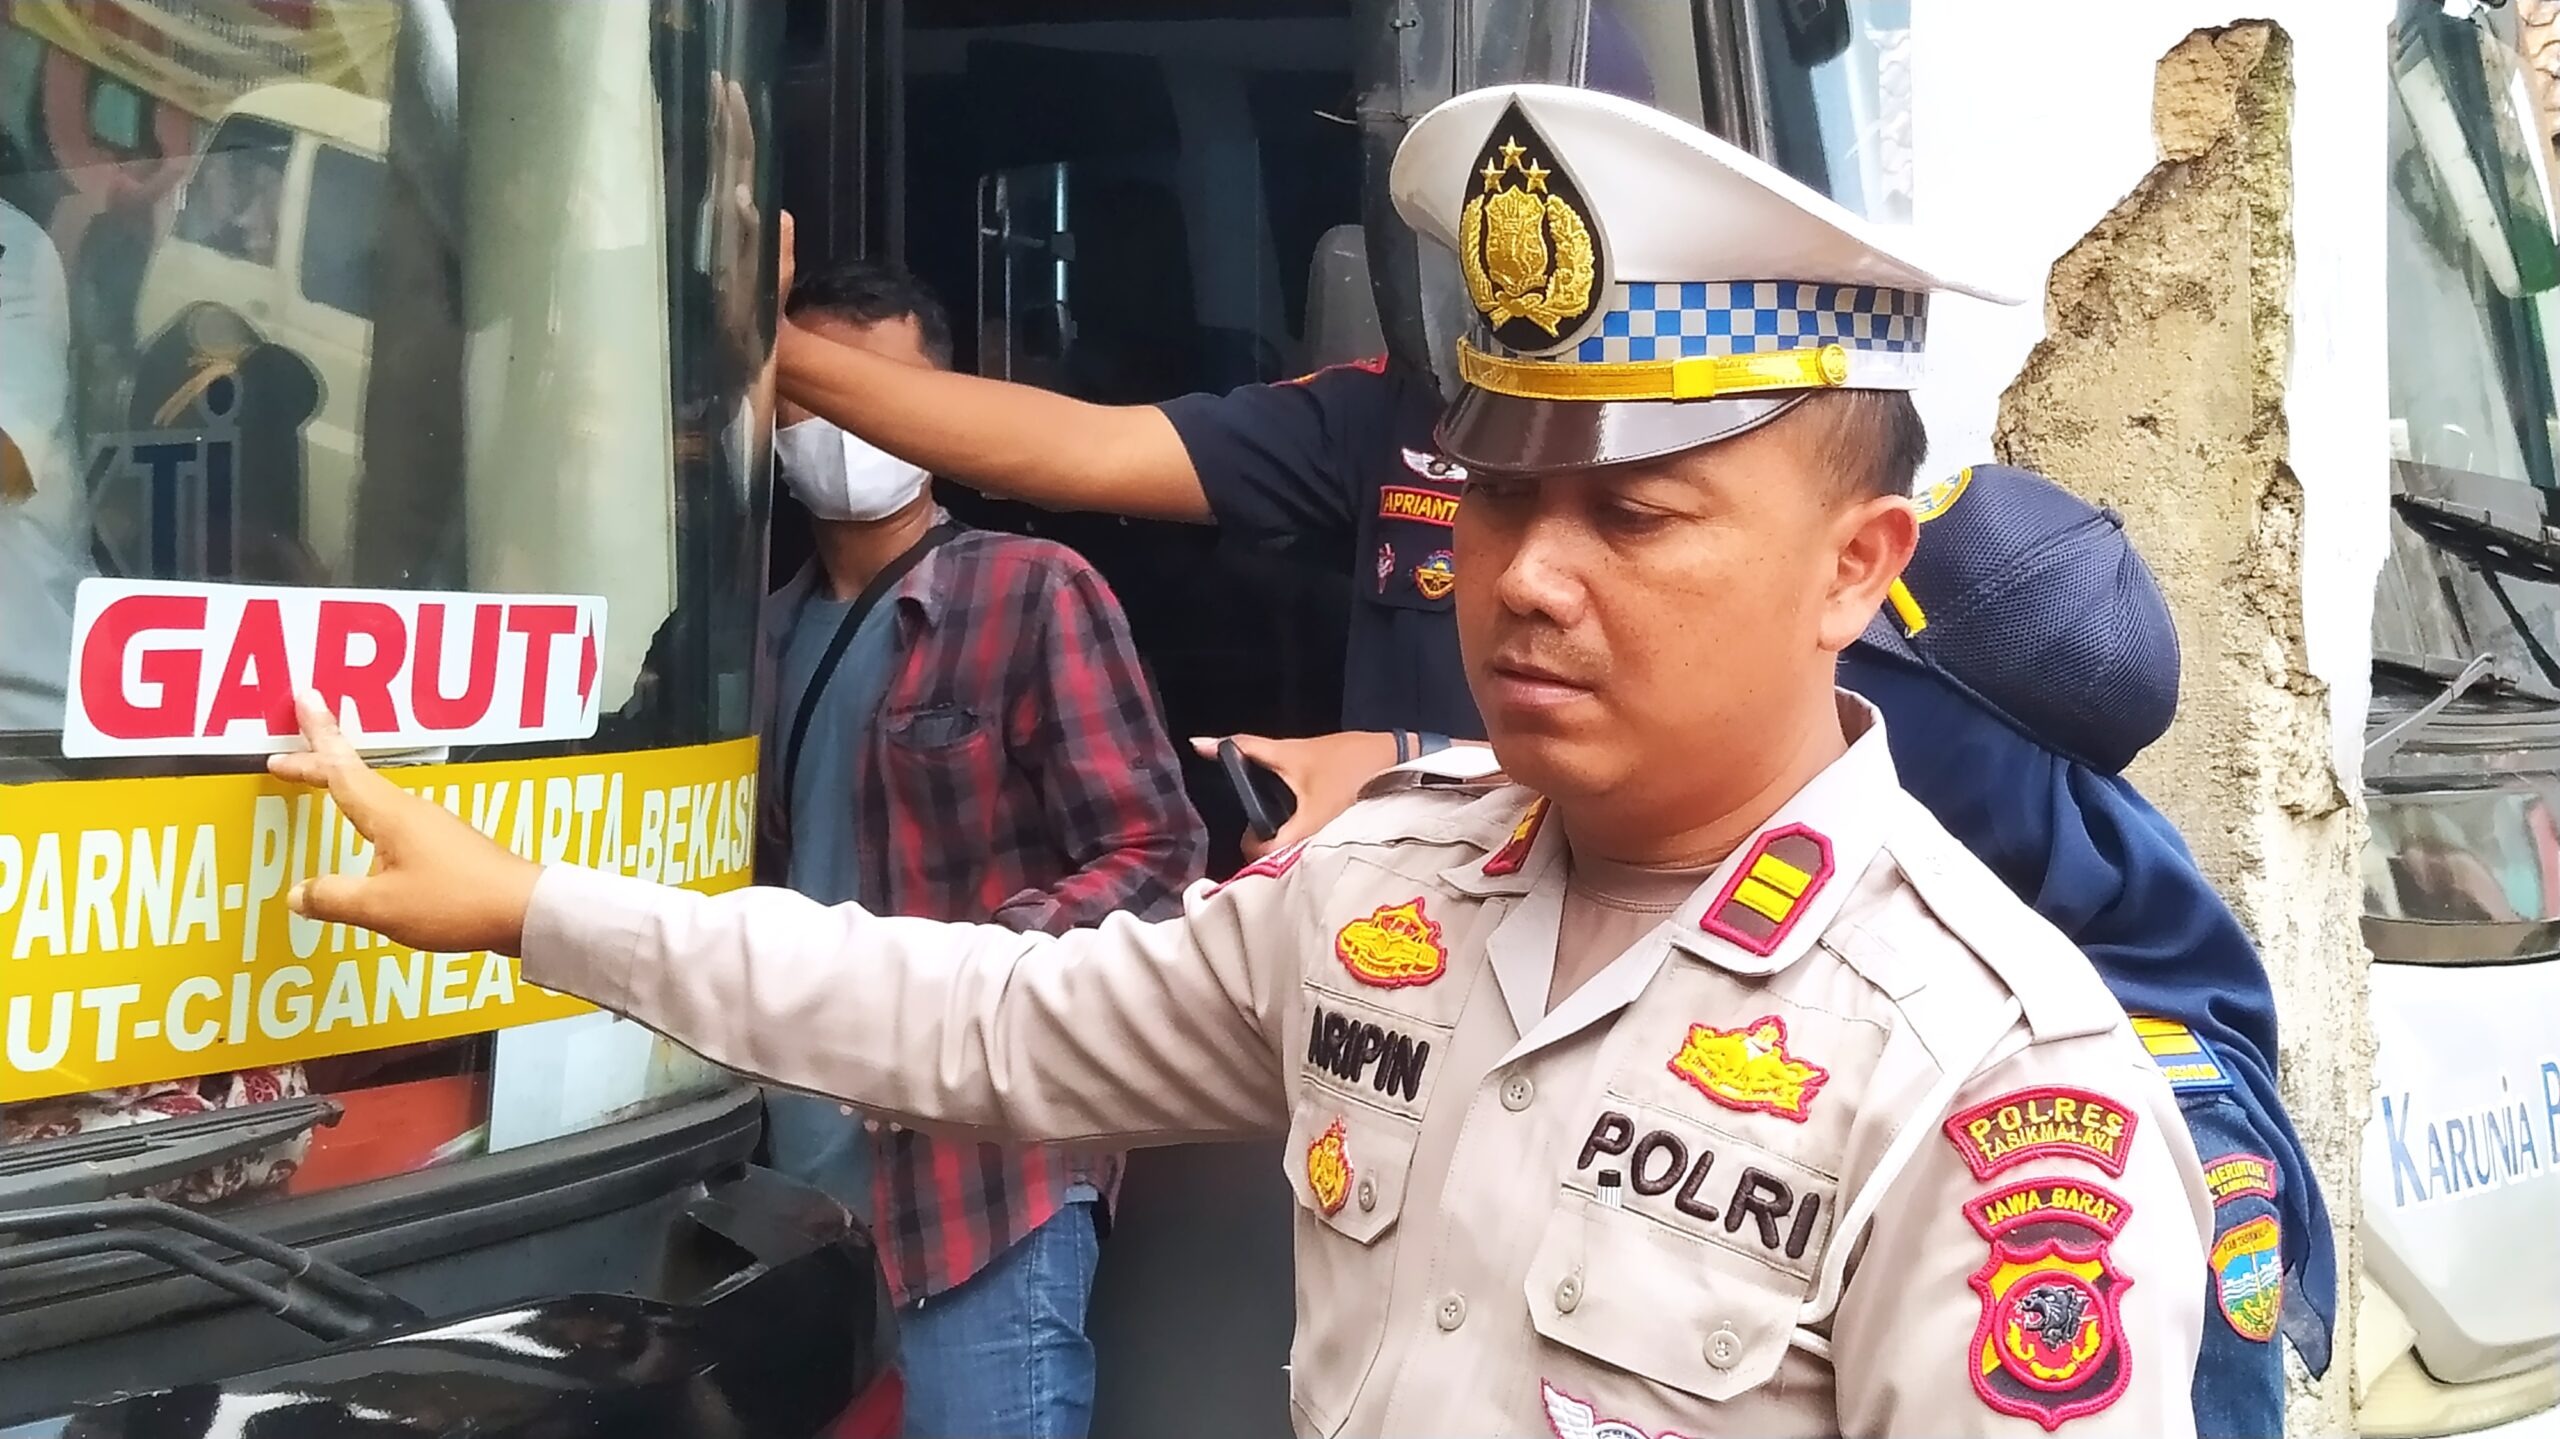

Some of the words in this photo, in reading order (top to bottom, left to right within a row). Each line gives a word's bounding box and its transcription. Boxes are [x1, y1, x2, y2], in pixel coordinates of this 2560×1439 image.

[80, 594, 578, 739] GARUT
[1969, 1097, 2125, 1145] POLRES
[1577, 1111, 1821, 1259] POLRI
[1985, 1190, 2042, 1226] JAWA
[2052, 1187, 2118, 1224] BARAT
